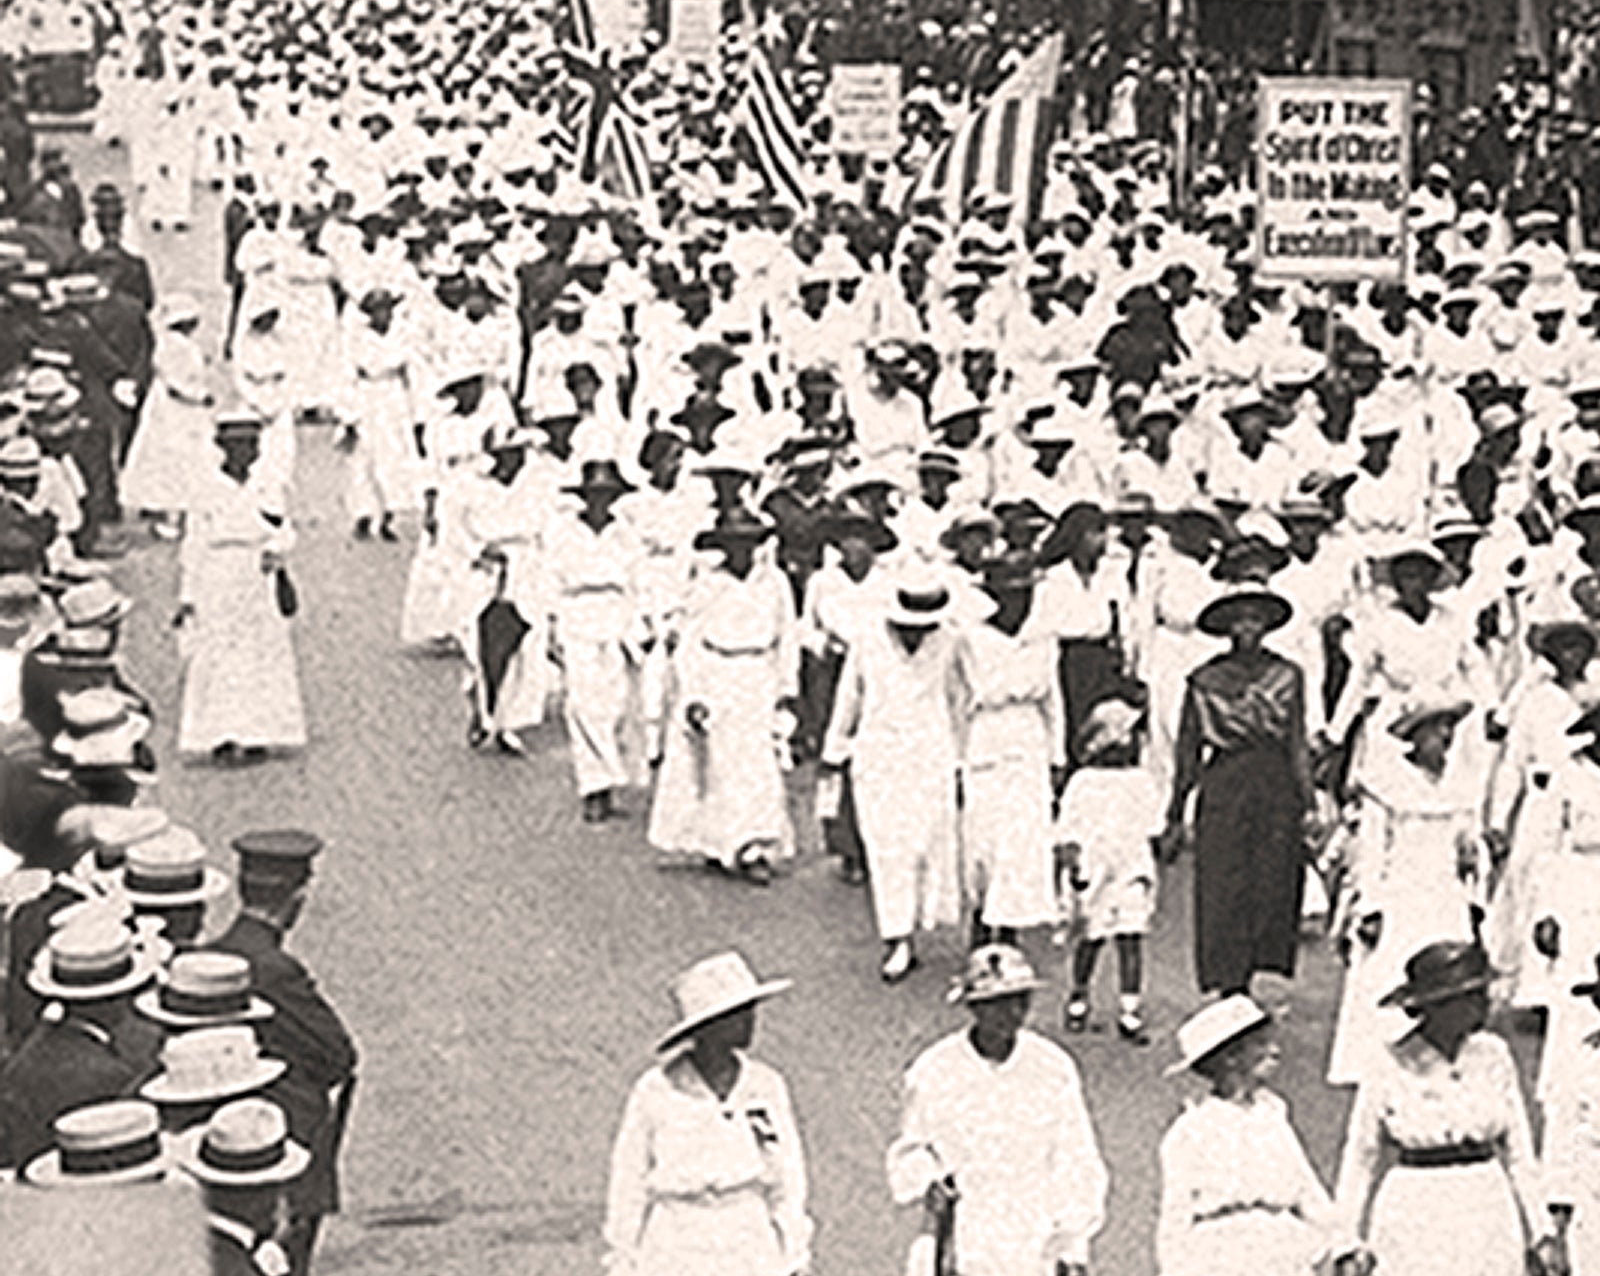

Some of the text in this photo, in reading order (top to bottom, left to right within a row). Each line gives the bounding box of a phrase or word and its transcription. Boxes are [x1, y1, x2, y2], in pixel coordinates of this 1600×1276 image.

[1279, 100, 1390, 128] PUT THE
[1306, 208, 1358, 221] AND
